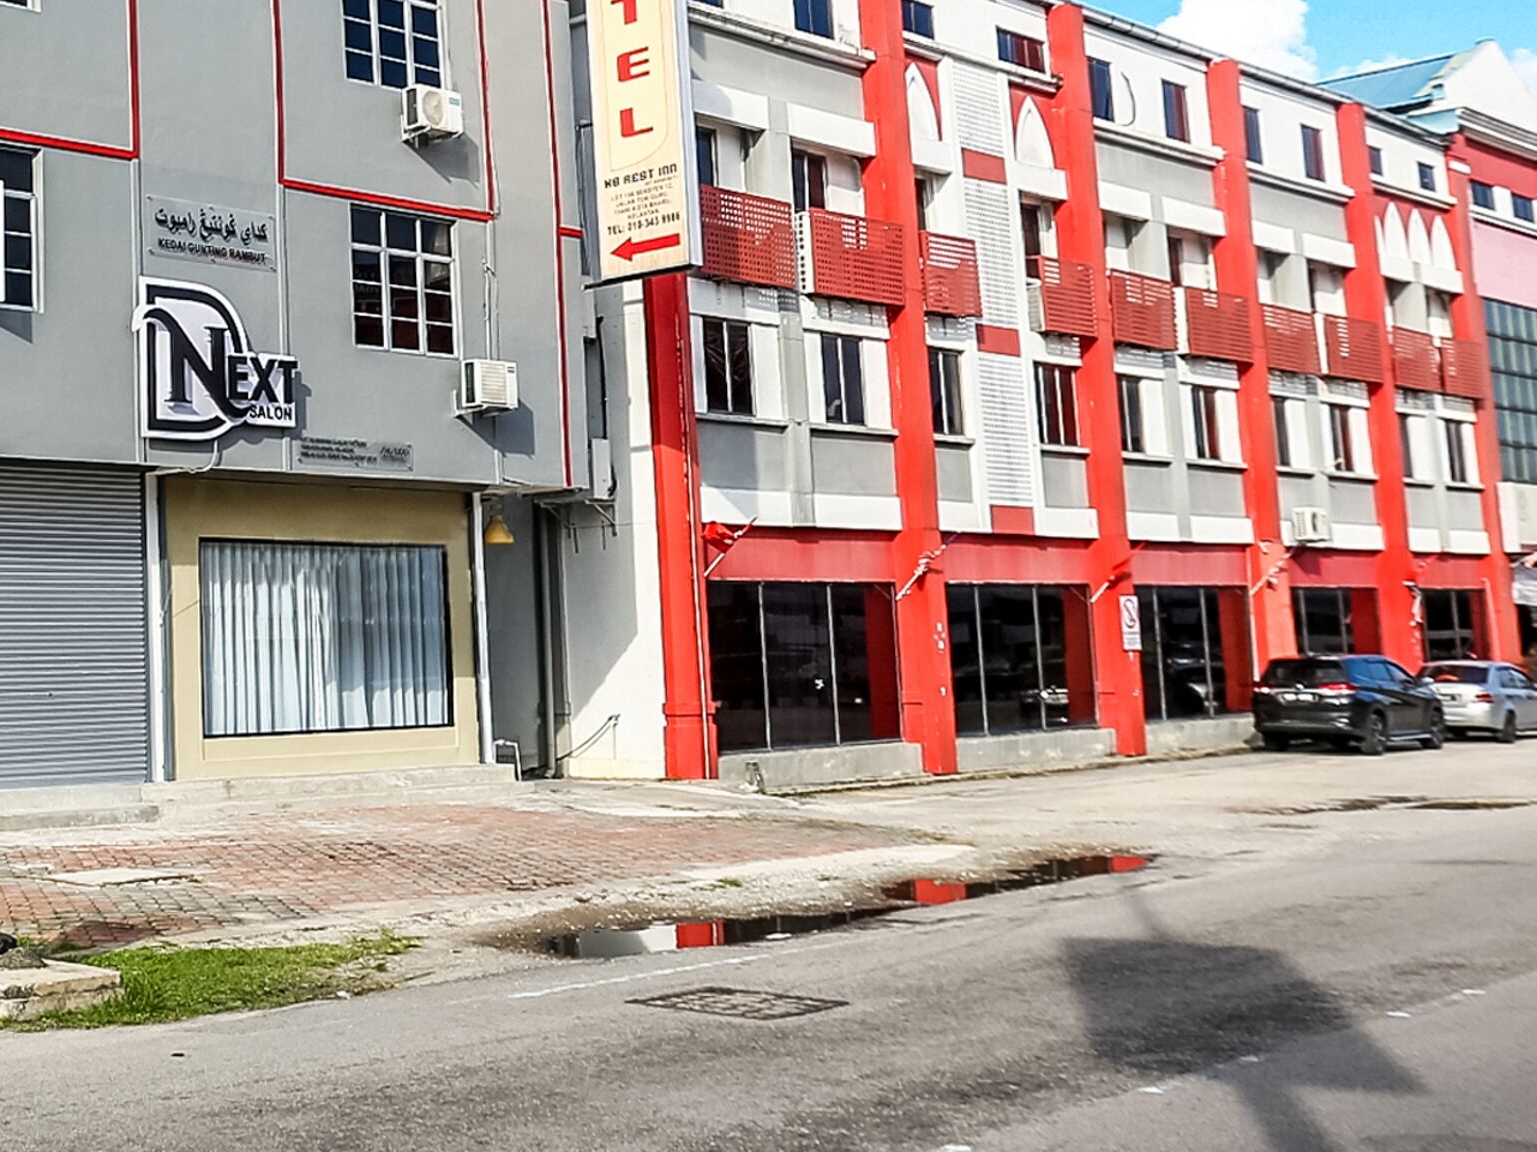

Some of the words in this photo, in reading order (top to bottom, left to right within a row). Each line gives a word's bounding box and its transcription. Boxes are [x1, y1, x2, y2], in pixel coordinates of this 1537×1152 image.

[623, 168, 654, 184] REST
[158, 237, 186, 251] KEDAI
[187, 242, 228, 257] GUNTING
[229, 248, 267, 263] RAMBUT
[249, 404, 292, 421] SALON
